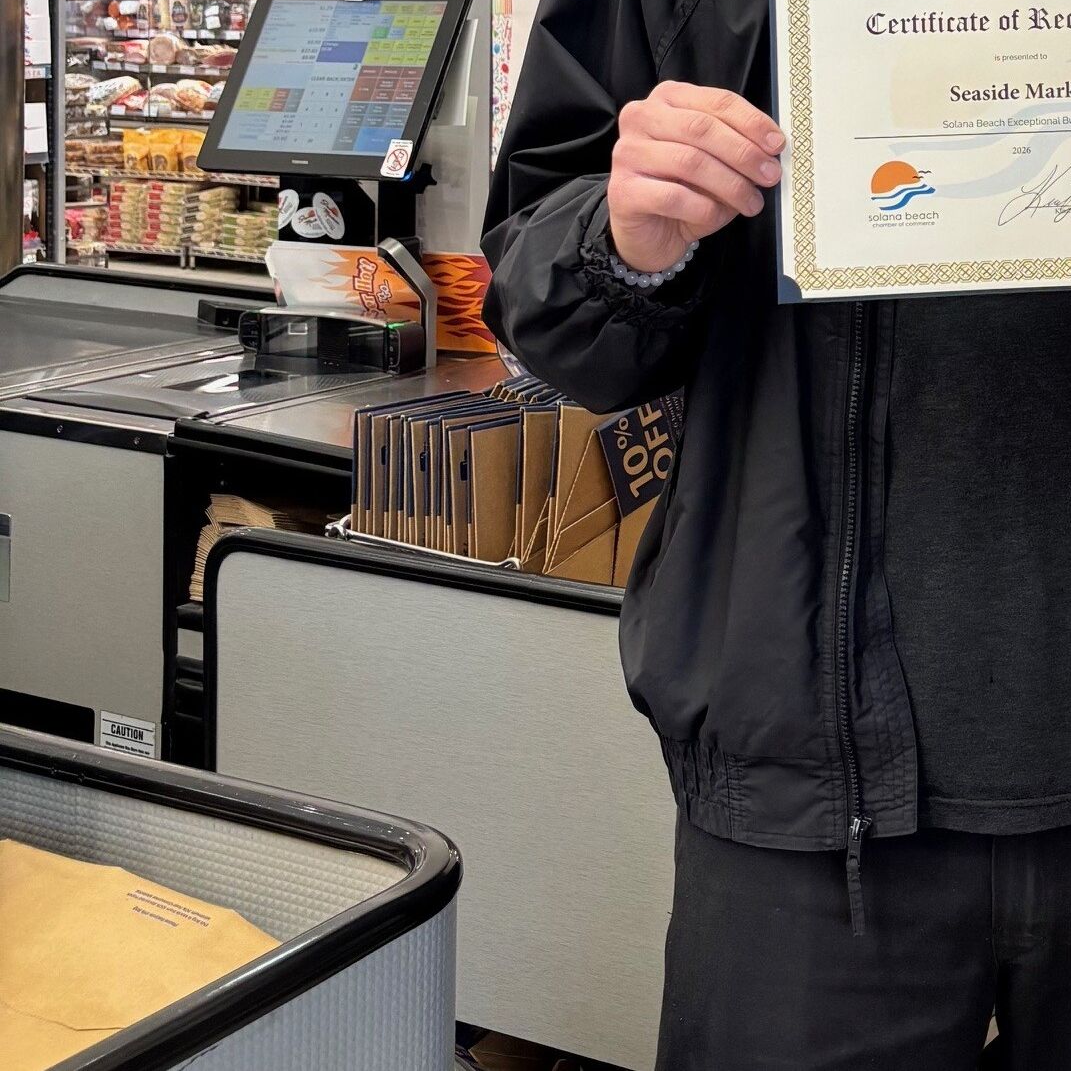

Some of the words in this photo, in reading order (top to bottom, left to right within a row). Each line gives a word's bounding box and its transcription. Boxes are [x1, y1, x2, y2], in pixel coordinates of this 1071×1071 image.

[865, 12, 990, 36] Certificate
[998, 8, 1020, 31] of
[1002, 53, 1038, 62] presented
[949, 83, 1020, 103] Seaside
[943, 120, 974, 128] Solana
[976, 119, 1005, 127] Beach
[1008, 116, 1061, 127] Exceptional
[1012, 146, 1032, 155] 2026
[868, 213, 902, 222] solana
[905, 211, 939, 220] beach
[638, 403, 674, 480] OFF
[614, 417, 654, 498] 10%
[111, 724, 144, 741] CAUTION
